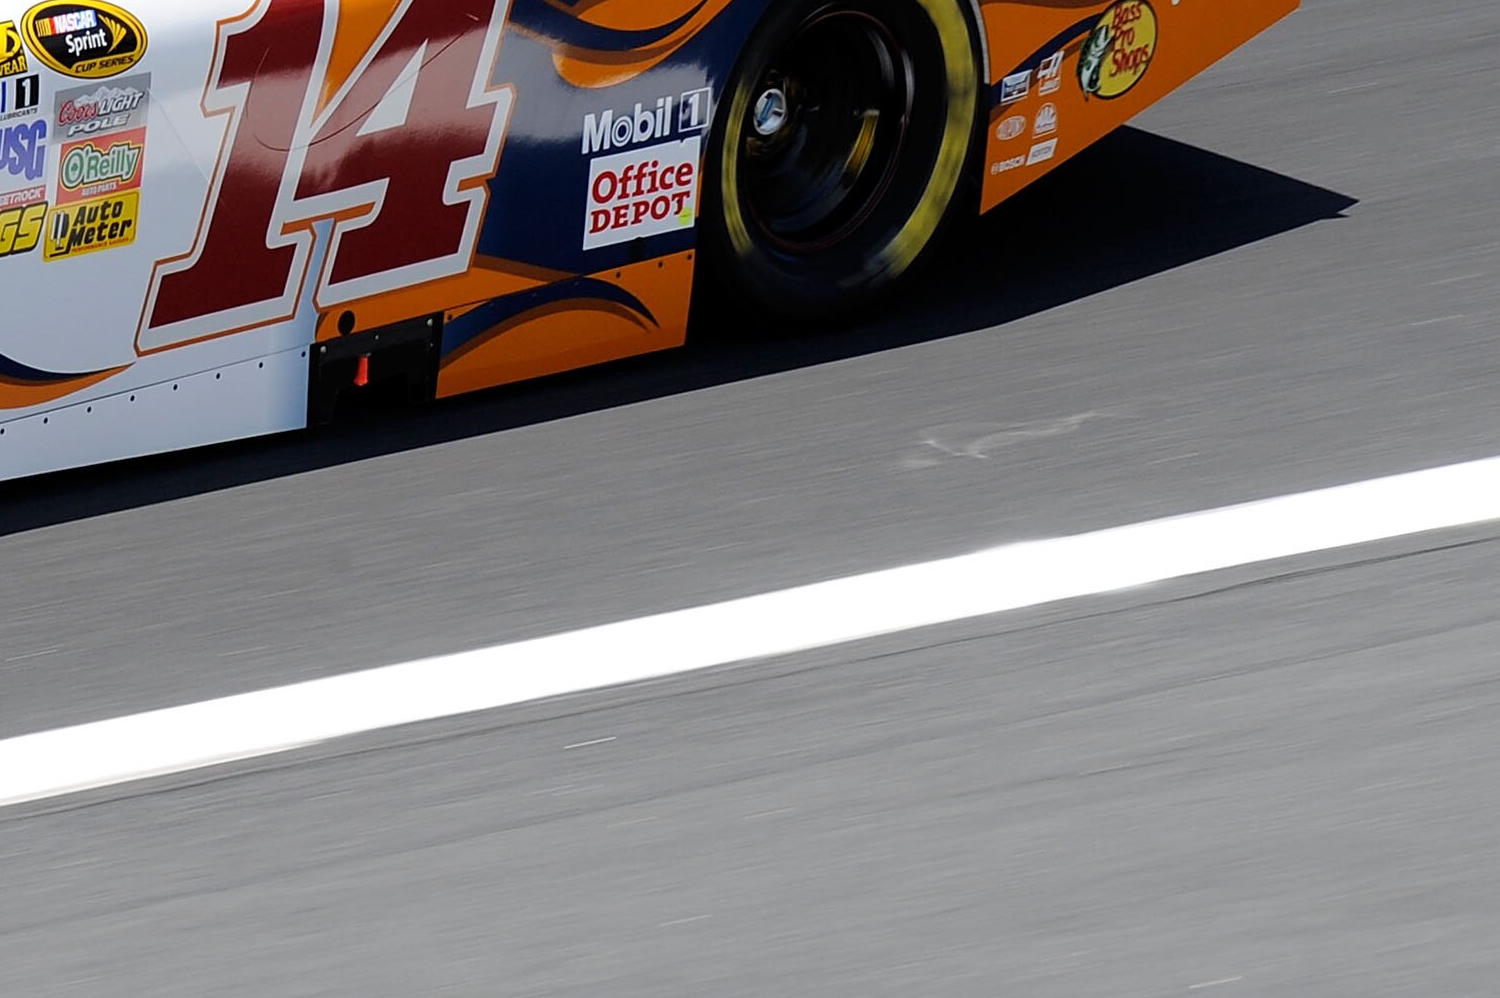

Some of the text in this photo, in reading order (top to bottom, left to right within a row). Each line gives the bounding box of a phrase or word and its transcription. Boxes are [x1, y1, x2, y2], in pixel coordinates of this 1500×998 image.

[51, 9, 99, 34] NASCAR
[1111, 1, 1142, 31] Bass
[64, 28, 109, 57] Sprint
[74, 54, 135, 74] CUP SERIES
[1109, 43, 1151, 78] Shops
[0, 107, 38, 121] LUBRICANTS
[58, 91, 145, 126] Coors LIGHT
[67, 113, 129, 137] POLE
[581, 96, 673, 155] Mobil
[64, 146, 140, 186] O'Reilly
[591, 161, 693, 204] Office
[73, 201, 124, 227] Auto
[588, 191, 691, 234] DEPOT
[68, 218, 132, 252] Meter
